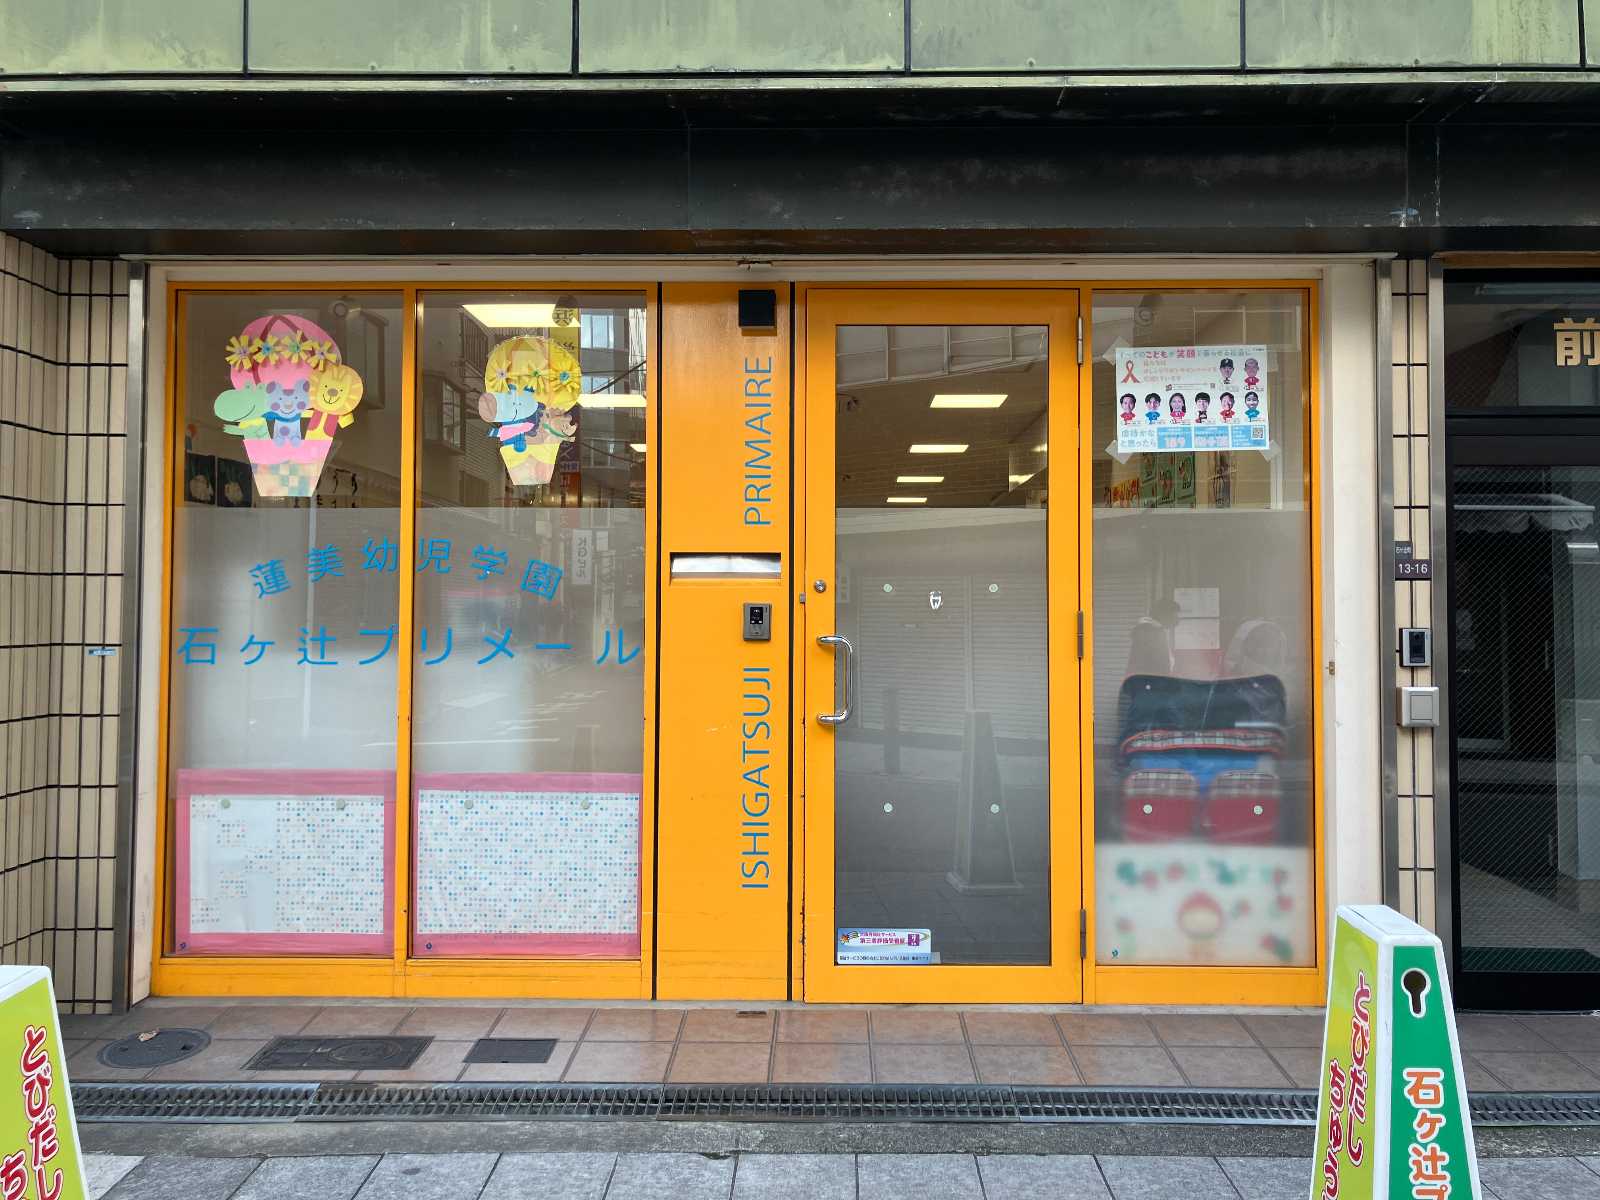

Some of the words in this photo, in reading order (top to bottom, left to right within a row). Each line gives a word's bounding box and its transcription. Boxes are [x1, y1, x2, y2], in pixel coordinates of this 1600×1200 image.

[1554, 317, 1600, 367] 前
[743, 356, 773, 526] PRIMAIRE
[248, 537, 563, 600] 蓮美幼児学園
[1398, 563, 1428, 574] 13-16
[176, 624, 642, 665] 石ケ辻プリメール
[741, 666, 772, 889] ISHIGATSUJI
[20, 1024, 64, 1200] とびだし
[1321, 1059, 1345, 1200] ちゅう
[1347, 971, 1370, 1167] とびだし
